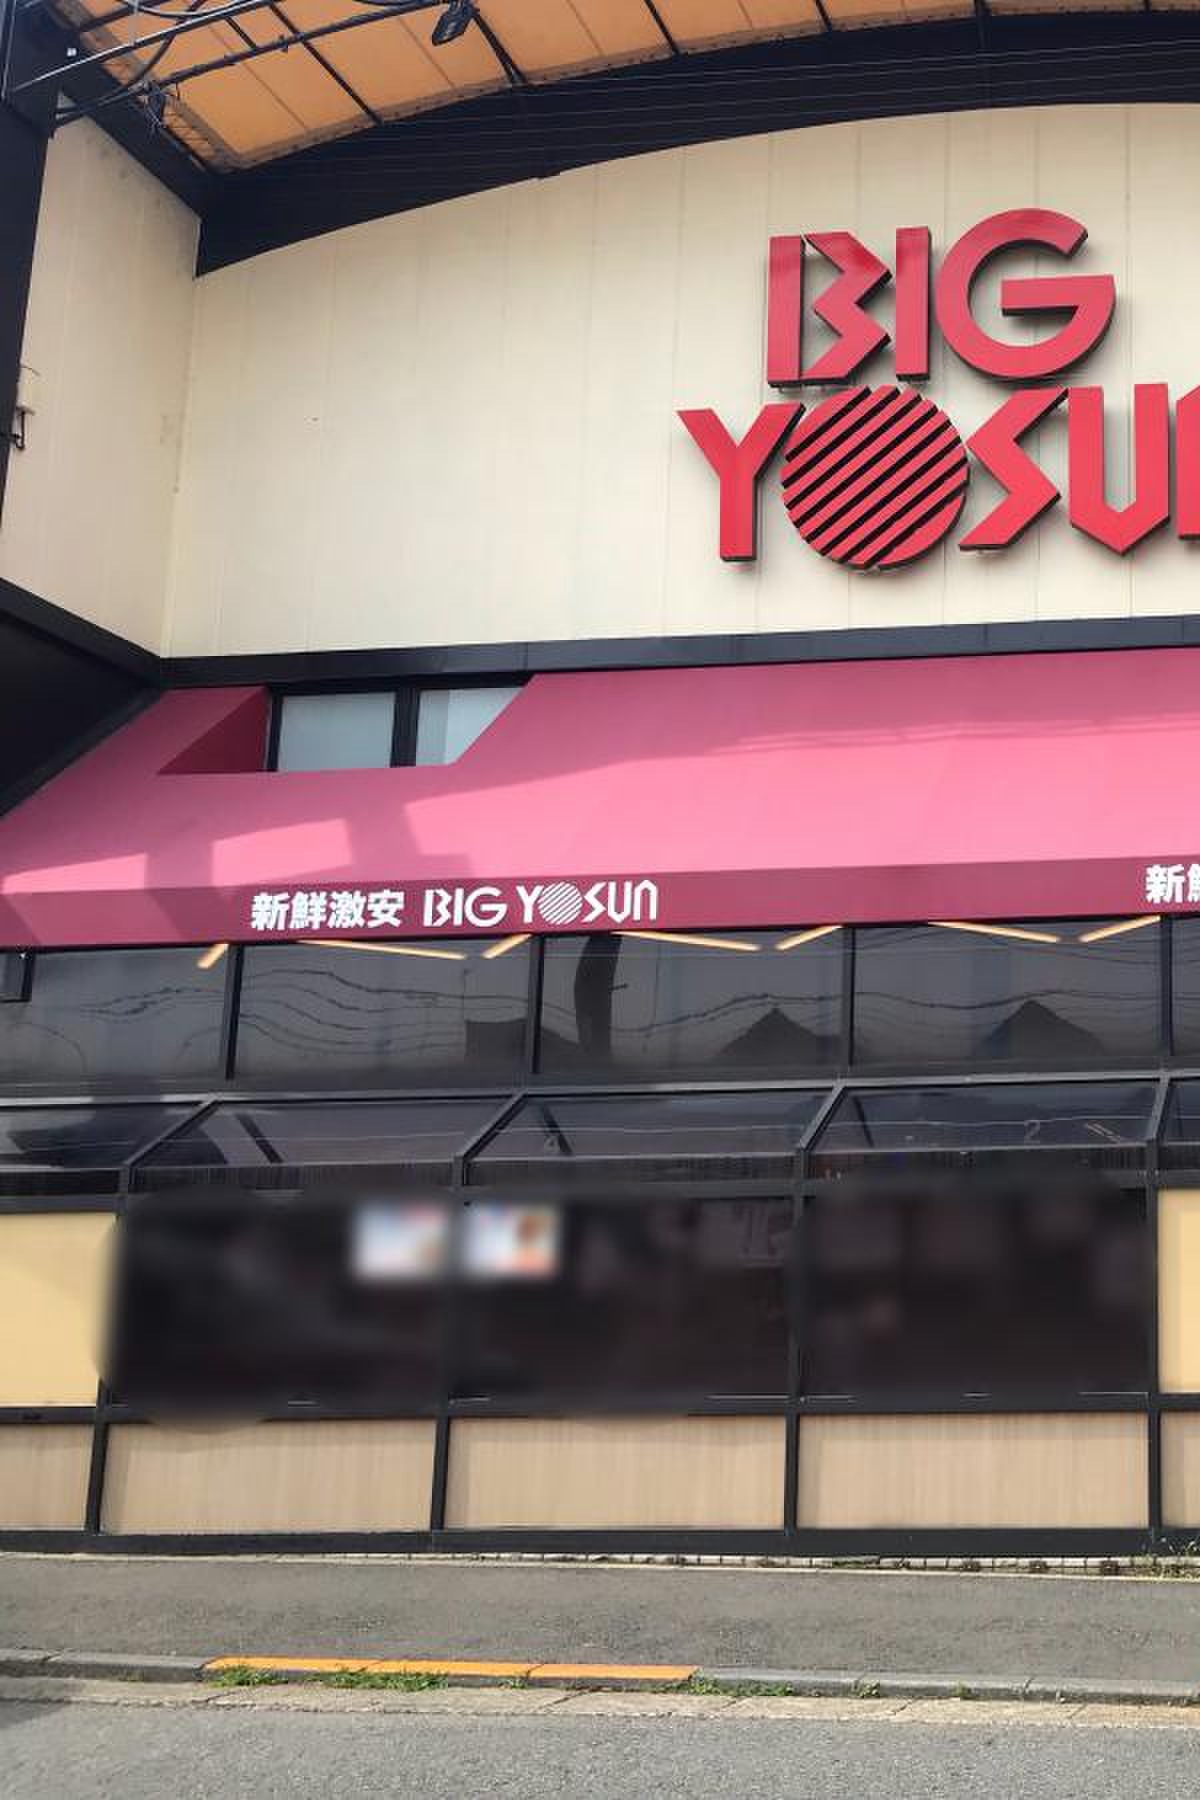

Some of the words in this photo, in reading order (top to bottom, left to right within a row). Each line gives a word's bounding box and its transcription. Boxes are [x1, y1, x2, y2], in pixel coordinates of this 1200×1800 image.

[767, 207, 1117, 389] BIG
[251, 889, 405, 931] 新鮮激安
[424, 886, 507, 928] BIG
[515, 879, 658, 925] YOSUN
